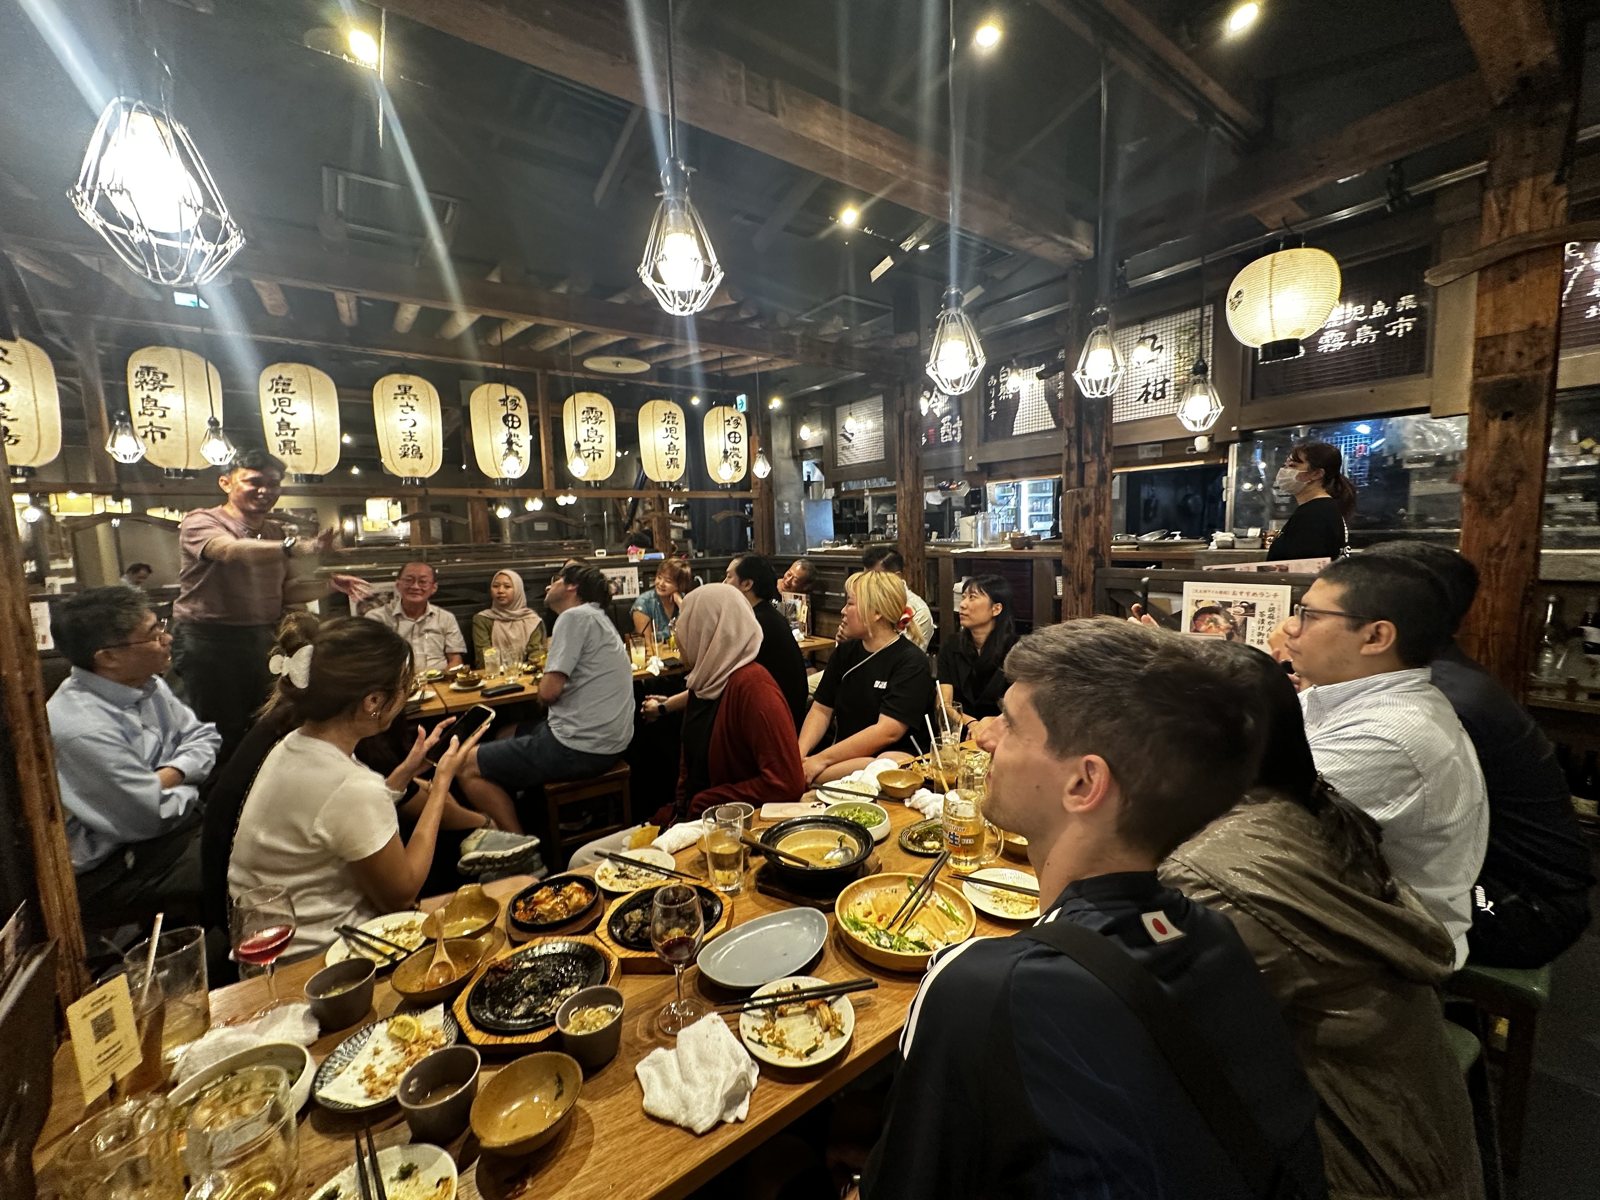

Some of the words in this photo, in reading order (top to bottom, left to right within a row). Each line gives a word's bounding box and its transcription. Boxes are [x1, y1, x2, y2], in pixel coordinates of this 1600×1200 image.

[1316, 317, 1418, 353] 霧島市
[133, 365, 175, 444] 霧島市
[267, 374, 302, 456] 鹿児島県
[393, 384, 424, 461] 黒さつま鶏
[987, 374, 998, 421] あります
[580, 406, 606, 462] 霧島市
[660, 410, 680, 470] 鹿児島県
